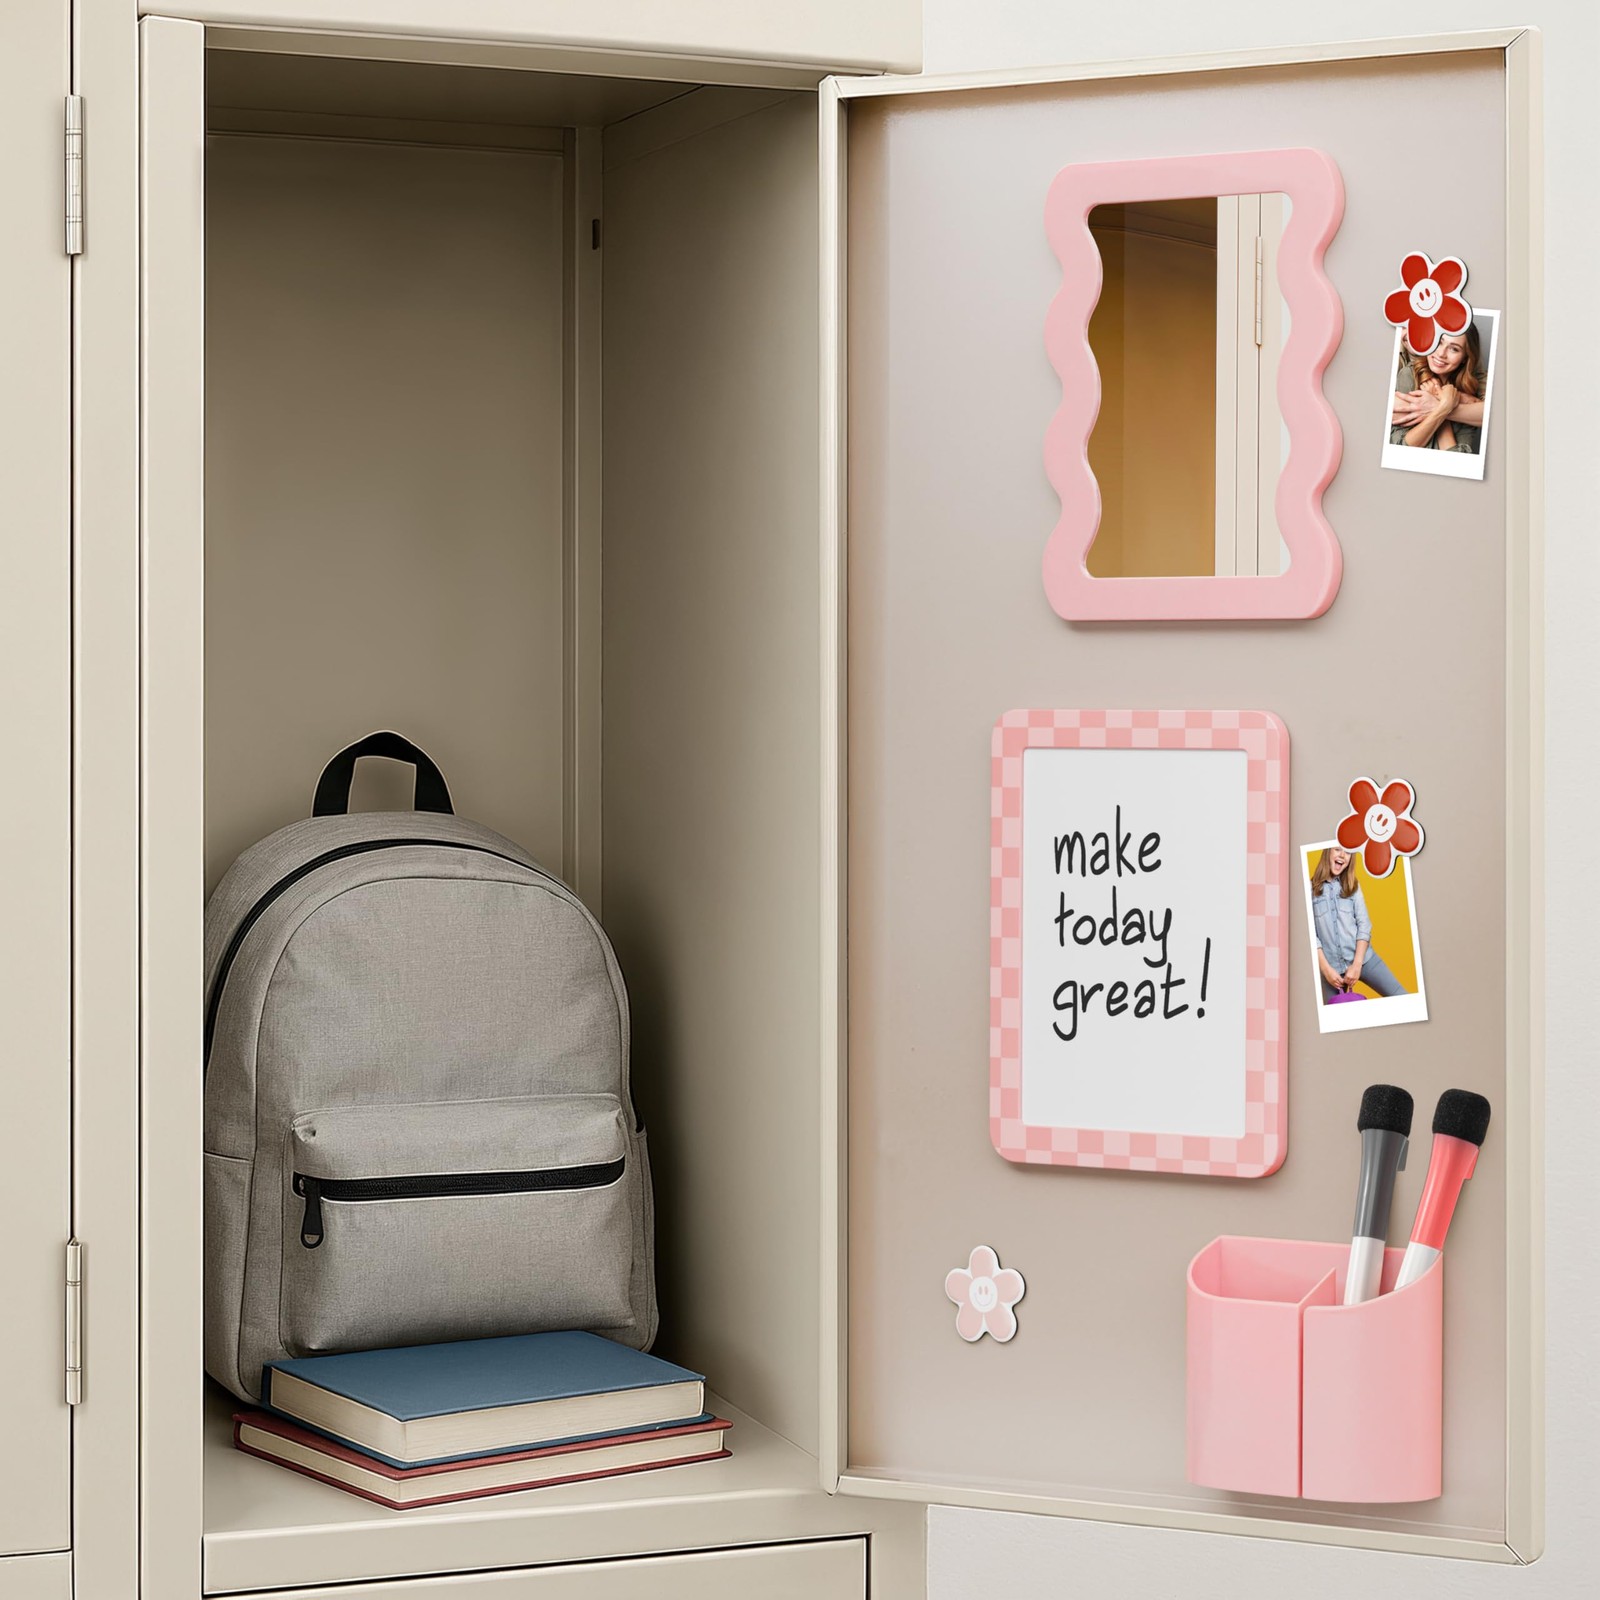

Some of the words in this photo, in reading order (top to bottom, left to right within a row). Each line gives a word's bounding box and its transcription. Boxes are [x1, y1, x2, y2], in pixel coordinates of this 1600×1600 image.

[1054, 804, 1162, 878] make
[1054, 885, 1173, 969] today
[1052, 937, 1211, 1042] great!
